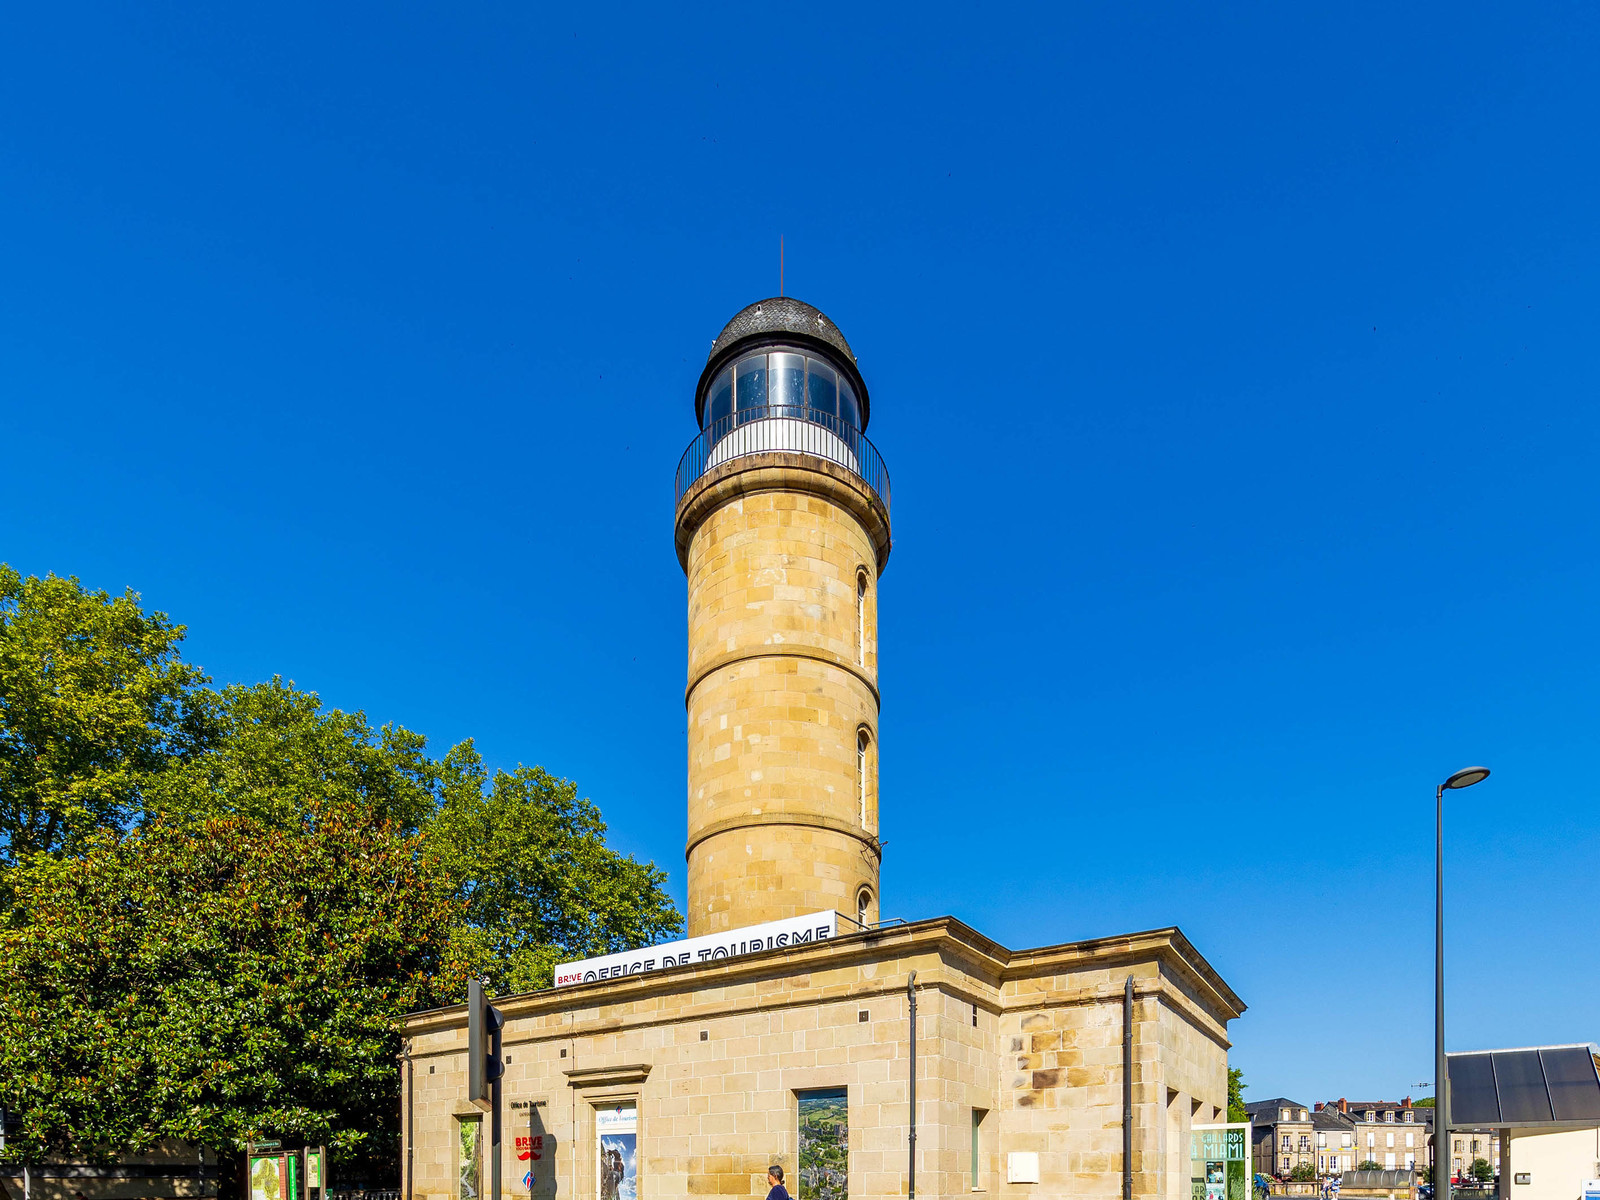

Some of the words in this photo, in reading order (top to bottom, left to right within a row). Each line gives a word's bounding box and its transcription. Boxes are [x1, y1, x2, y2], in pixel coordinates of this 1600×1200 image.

[583, 959, 655, 983] OFFICE
[662, 952, 691, 970] DE
[698, 925, 830, 962] TOURISME
[1201, 1132, 1243, 1144] GAILLARDS
[1203, 1143, 1243, 1158] MIAMI
